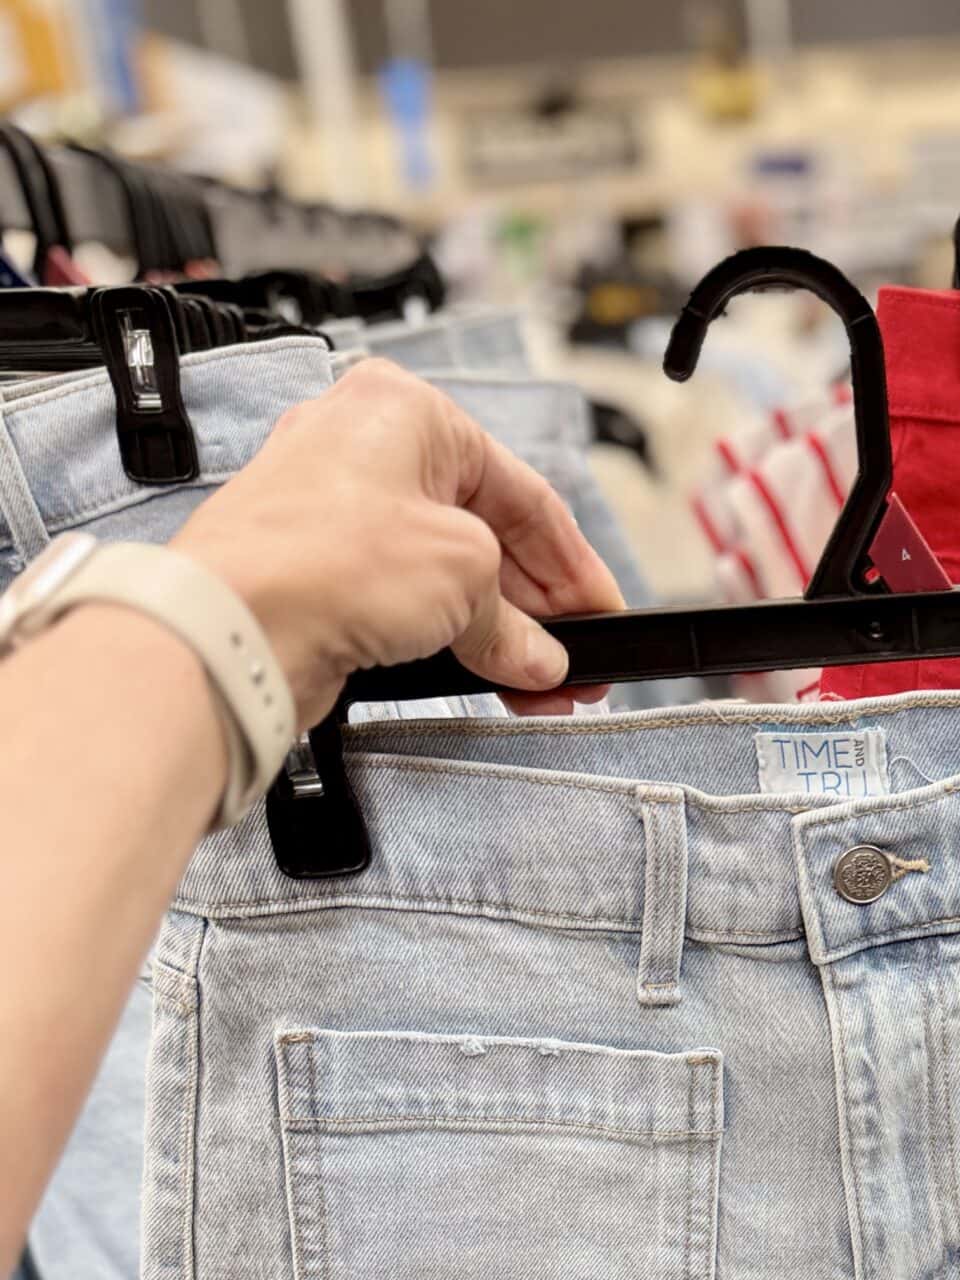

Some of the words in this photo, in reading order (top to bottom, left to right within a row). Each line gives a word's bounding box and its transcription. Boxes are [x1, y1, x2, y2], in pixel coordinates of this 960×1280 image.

[902, 548, 911, 561] 4
[772, 739, 853, 769] TIME
[854, 739, 865, 767] AND
